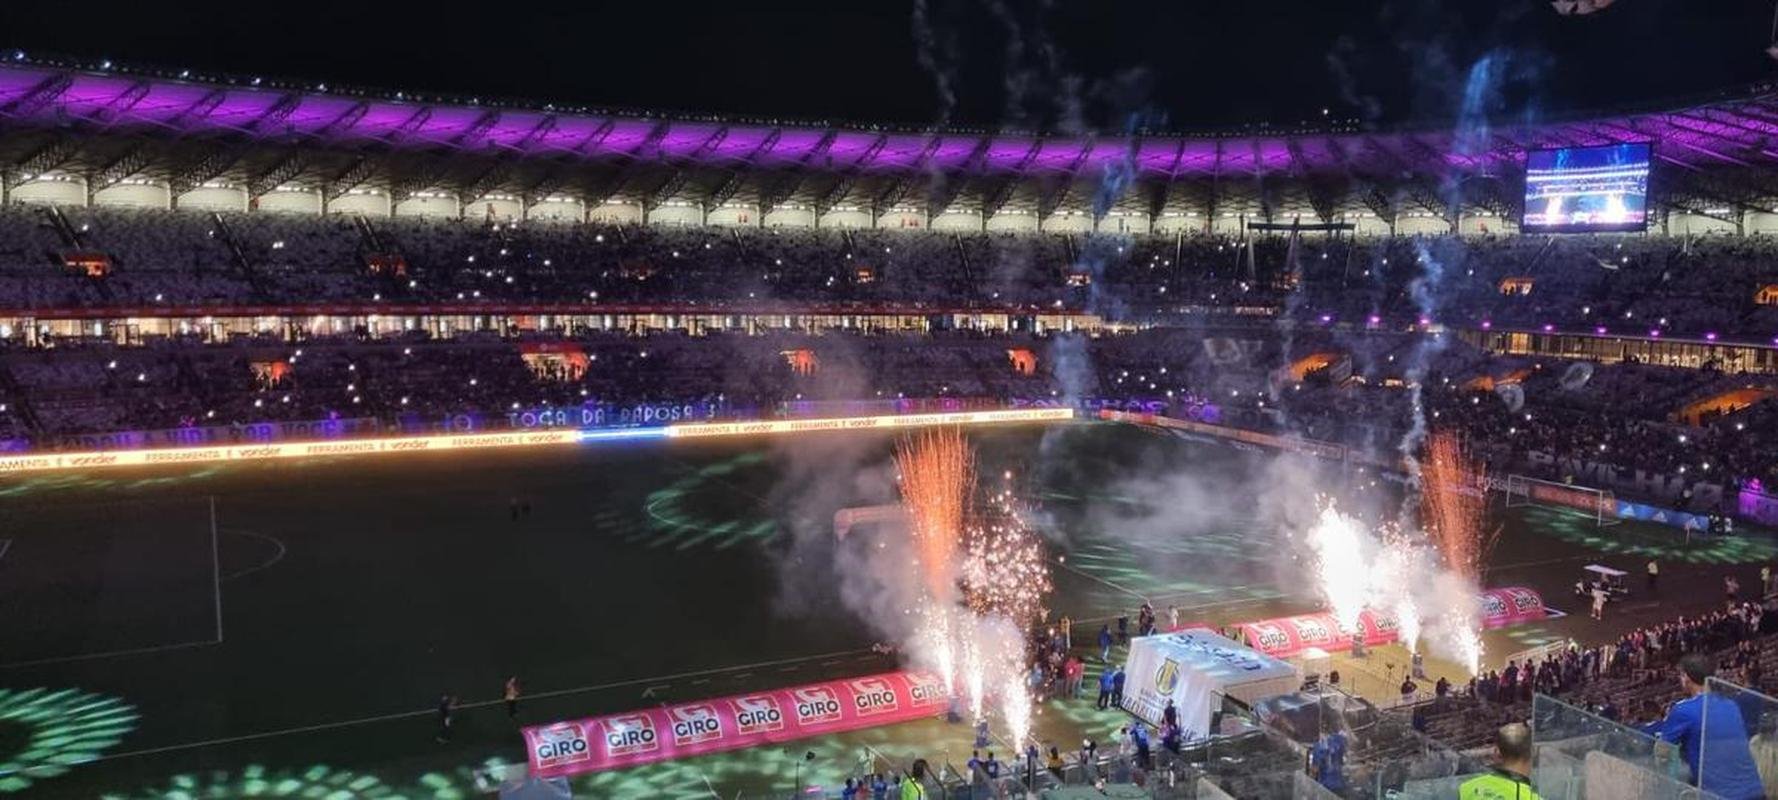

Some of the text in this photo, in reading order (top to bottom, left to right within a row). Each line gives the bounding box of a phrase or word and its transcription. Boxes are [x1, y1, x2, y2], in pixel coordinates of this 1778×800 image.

[1258, 632, 1288, 648] GIRO
[1300, 627, 1327, 641] GIRO
[856, 691, 895, 709] GIRO
[910, 683, 949, 700] GIRO
[738, 709, 780, 727] GIRO
[798, 700, 839, 718] GIRO
[674, 718, 719, 737] GIRO
[607, 729, 655, 748] GIRO
[537, 738, 587, 759] GIRO
